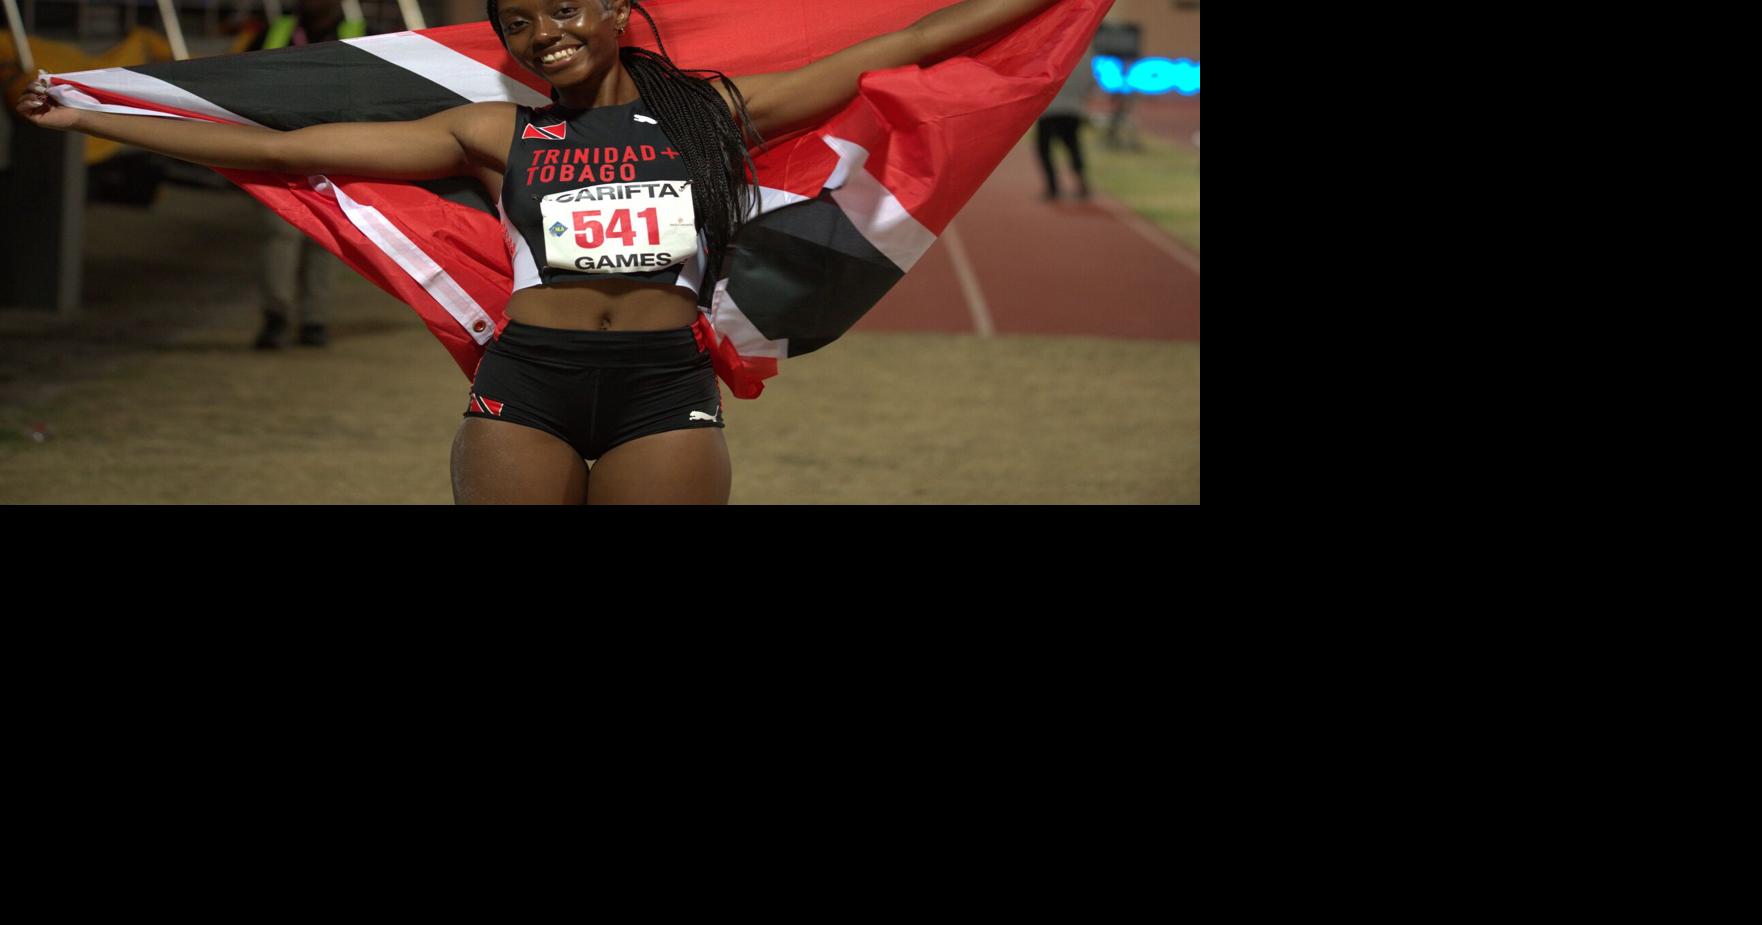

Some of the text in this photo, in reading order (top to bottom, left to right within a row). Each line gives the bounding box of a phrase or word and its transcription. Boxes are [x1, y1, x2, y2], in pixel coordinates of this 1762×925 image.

[526, 163, 637, 186] TOBAGO
[572, 207, 661, 249] 541
[575, 252, 672, 270] GAMES
